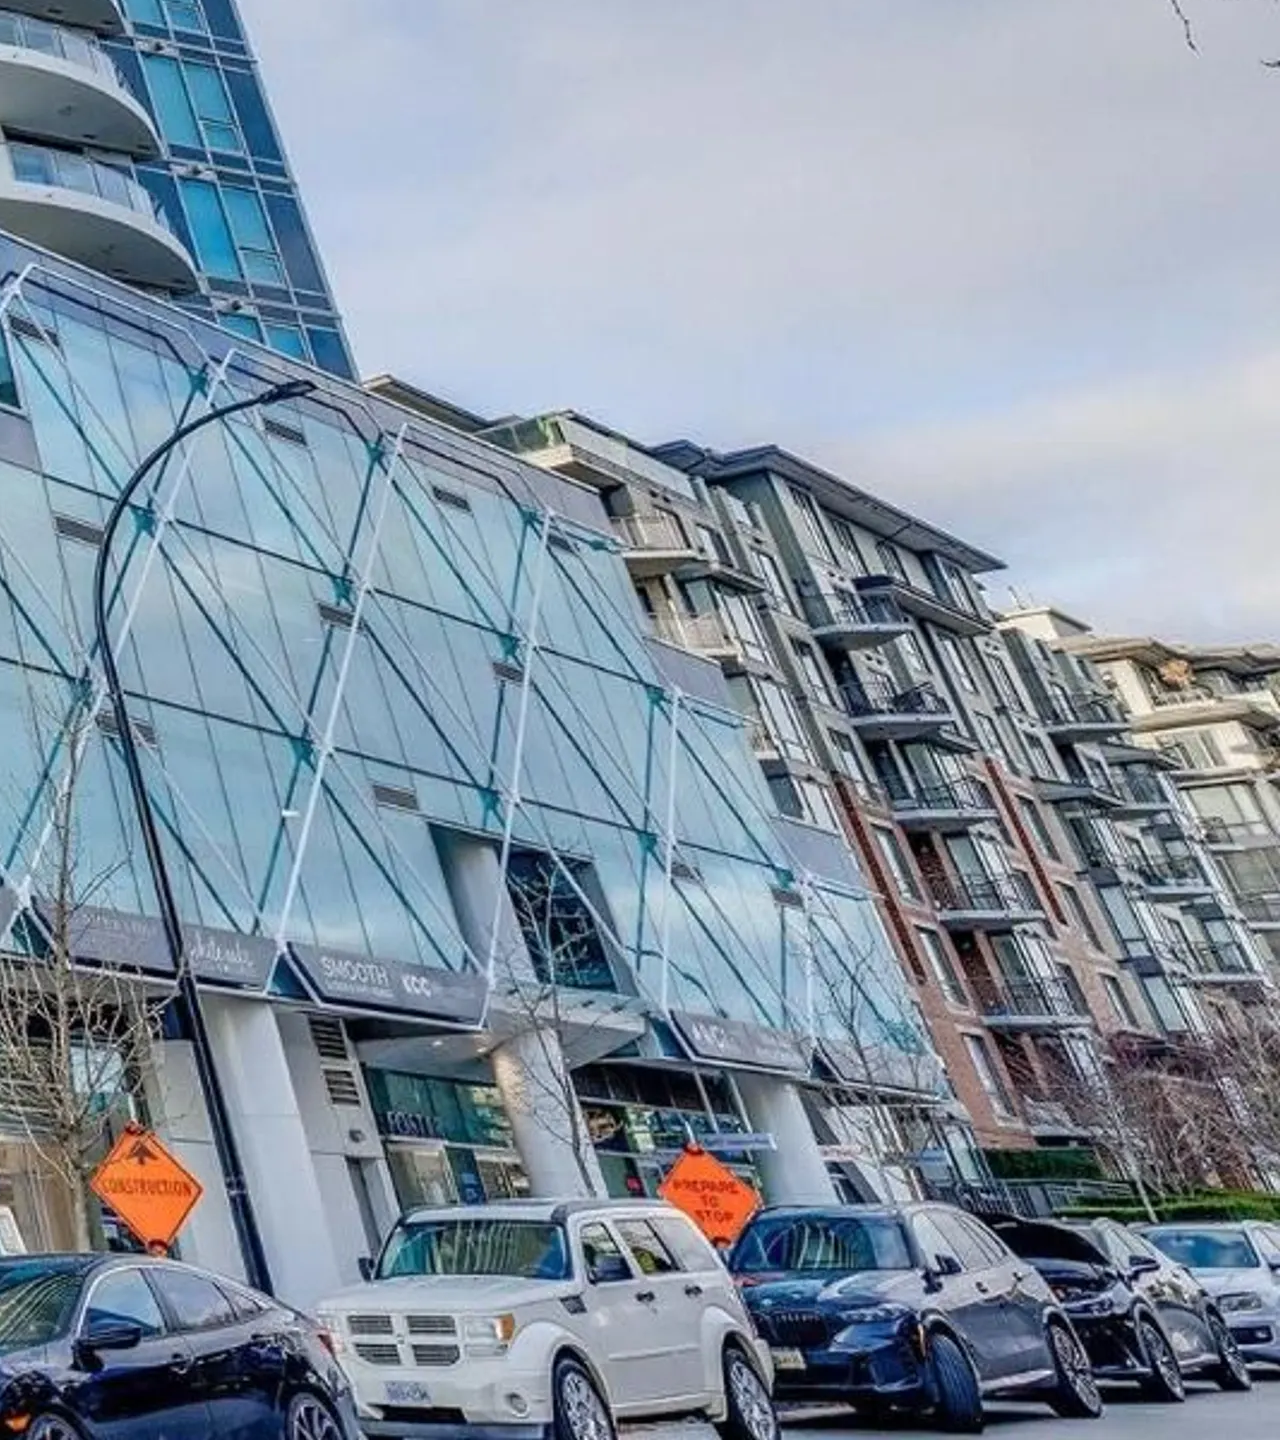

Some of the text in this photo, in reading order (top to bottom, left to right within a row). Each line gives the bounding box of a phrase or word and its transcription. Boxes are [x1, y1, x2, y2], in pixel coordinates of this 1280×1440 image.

[320, 956, 389, 987] SMOOTH
[100, 1178, 192, 1196] CONSTRUCTION
[672, 1179, 739, 1195] PREPARE
[701, 1194, 719, 1208] TO
[694, 1210, 734, 1223] STOP
